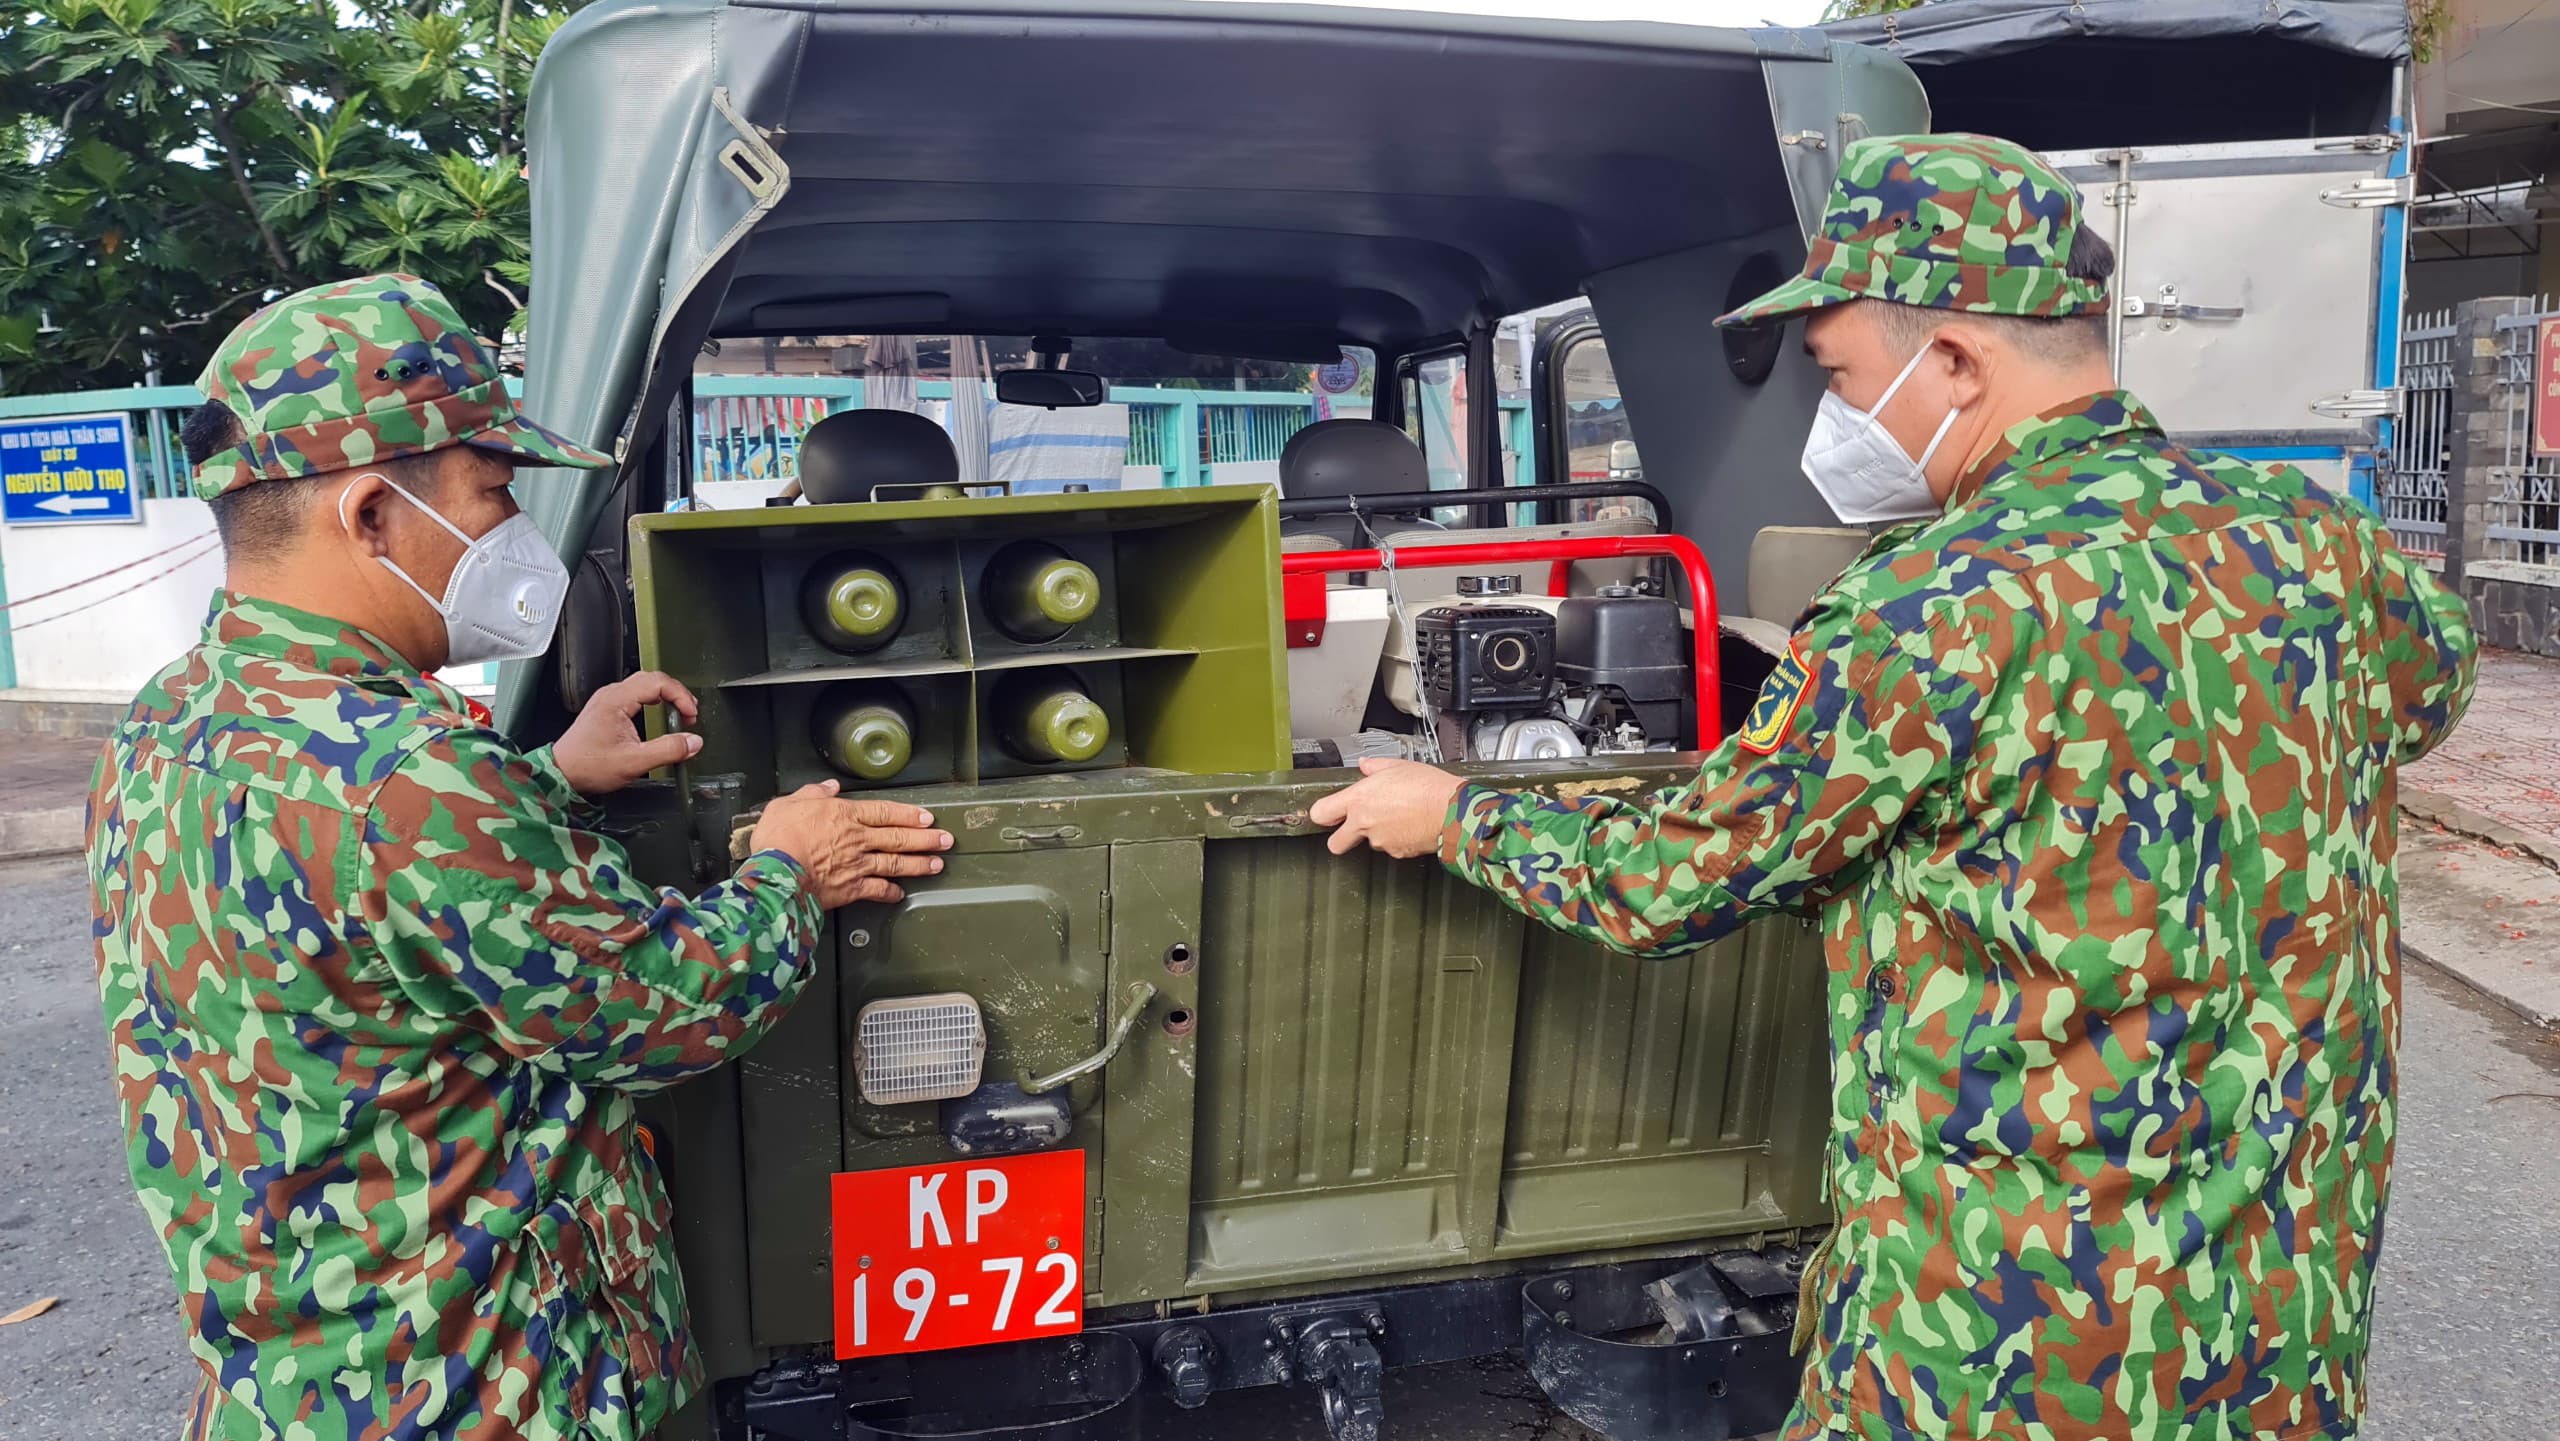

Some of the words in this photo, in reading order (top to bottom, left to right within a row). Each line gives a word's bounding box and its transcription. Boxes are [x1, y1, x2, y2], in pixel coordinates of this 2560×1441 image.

[96, 427, 119, 443] SINH
[5, 465, 62, 494] NGUYỄN
[63, 466, 94, 491] HỮU
[96, 468, 126, 494] THỌ
[909, 1168, 1009, 1249] KP
[853, 1252, 1078, 1347] 19-72
